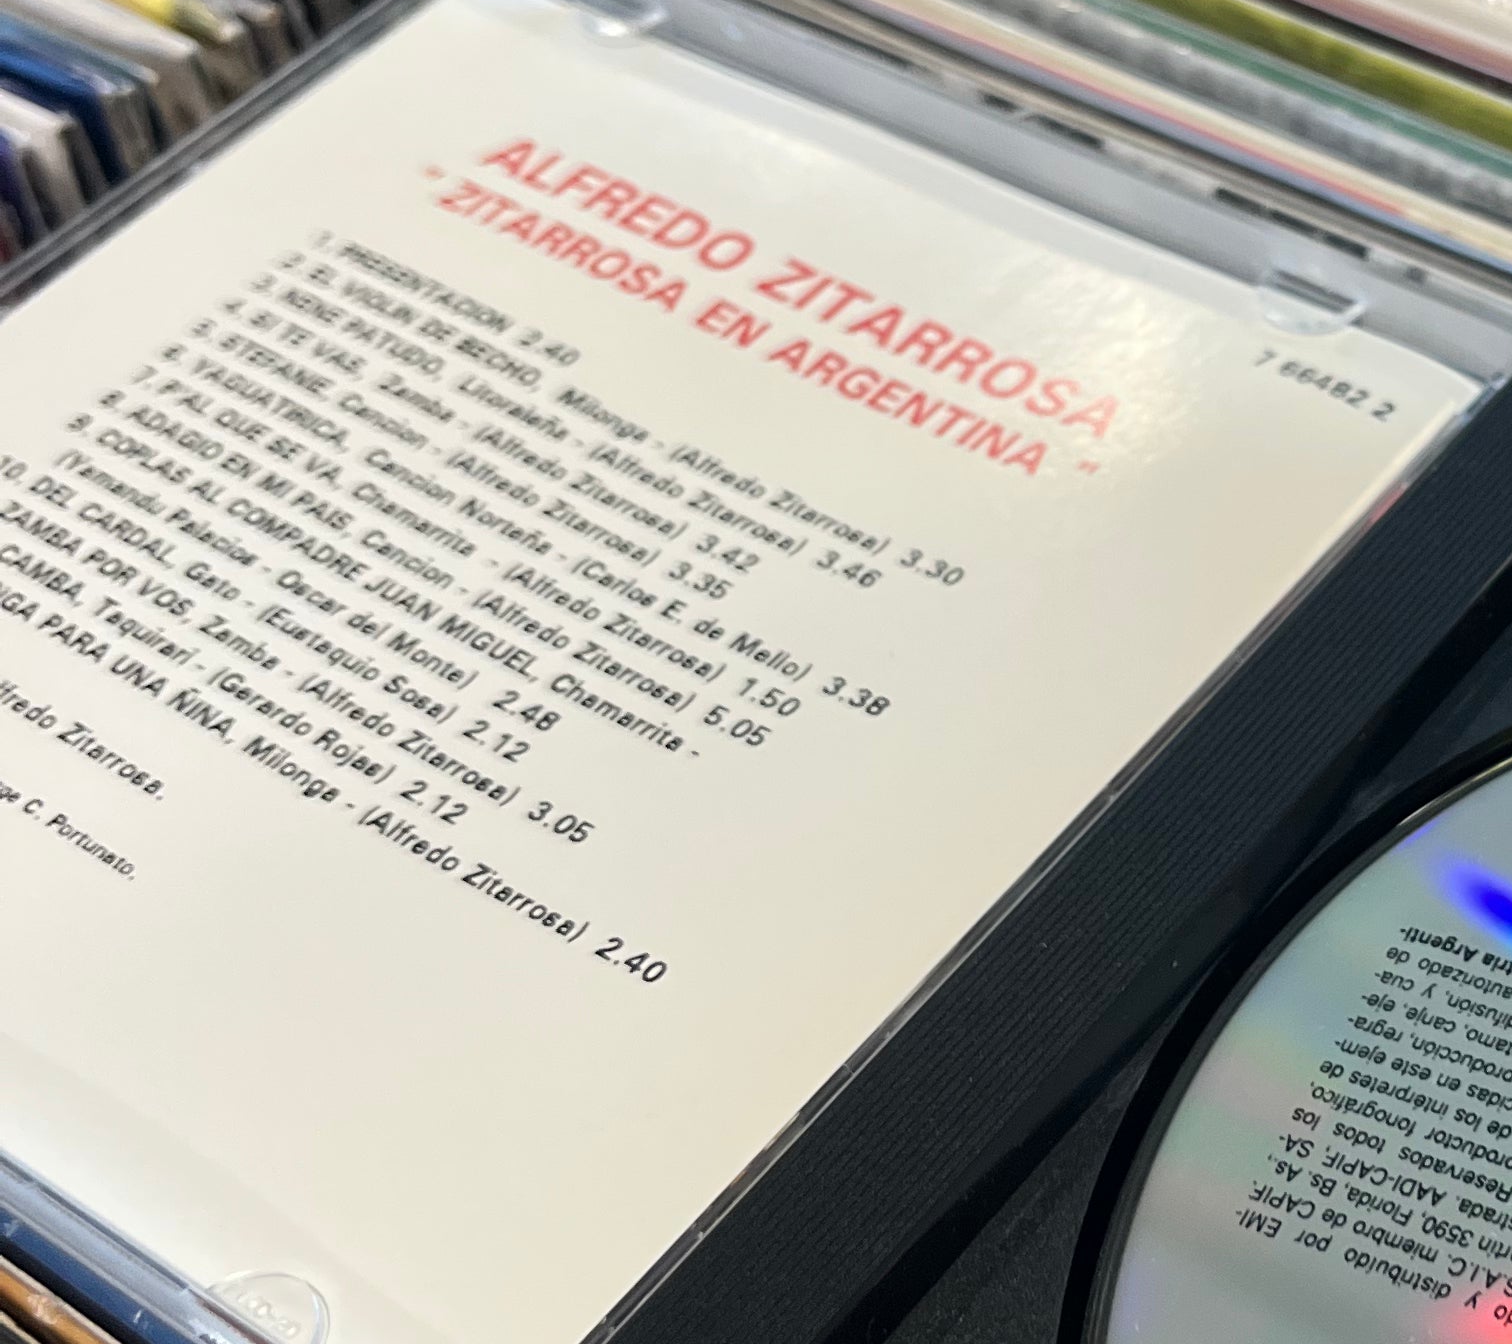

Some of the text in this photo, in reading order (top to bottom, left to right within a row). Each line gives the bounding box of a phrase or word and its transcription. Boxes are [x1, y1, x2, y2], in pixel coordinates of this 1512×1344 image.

[480, 138, 1115, 437] ALFREDO ZITARROSA
[693, 298, 771, 348] EN
[666, 561, 733, 600] 3.35
[898, 548, 965, 587] 3.30
[224, 497, 684, 752] COMPADRE JUAN MIGUEL, Chamarrita
[384, 630, 561, 732] Monte) 2.48
[470, 590, 772, 747] (Alfredo Zitarrosa) 5.05
[601, 612, 801, 717] Zitarrosa) 1.50
[727, 632, 891, 716] Mello) 3.38
[80, 548, 595, 843] POR VOS, Zamba (Alfredo Zitarrosa) 3.05
[381, 674, 458, 725] Sosa)
[460, 719, 530, 763] 2.12
[55, 721, 163, 800] Zitarrosa.
[311, 727, 396, 785] Rojas)
[398, 779, 468, 825] 2.12
[36, 613, 667, 983] PARA UNA ÑINA, Milonga (Alfredo Zitarrosa) 2.40
[1385, 945, 1411, 965] de
[1399, 926, 1479, 962] Argenti-
[1373, 969, 1415, 991] cua-
[1419, 981, 1437, 999] y
[1360, 992, 1396, 1012] eje-
[1402, 1002, 1457, 1033] canje,
[1346, 1014, 1404, 1042] regra-
[1318, 1059, 1345, 1079] de
[1333, 1038, 1387, 1064] ejem-
[1389, 1056, 1432, 1080] este
[1347, 1069, 1449, 1120] intérpretes
[1435, 1071, 1461, 1091] en
[1290, 1106, 1321, 1131] los
[1309, 1080, 1417, 1137] fonográfico,
[1452, 1107, 1483, 1132] los
[1278, 1132, 1315, 1158] SA-
[1331, 1121, 1386, 1154] todos
[1485, 1119, 1512, 1140] de
[1307, 1170, 1337, 1197] Bs.
[1320, 1145, 1447, 1207] AADI-CAPIF,
[1247, 1179, 1316, 1219] CAPIF.
[1343, 1181, 1414, 1227] Florida,
[1235, 1208, 1282, 1238] EMI-
[1320, 1207, 1347, 1229] de
[1420, 1210, 1474, 1248] 3590,
[1293, 1228, 1333, 1252] por
[1351, 1218, 1439, 1263] miembro
[1463, 1289, 1482, 1309] y
